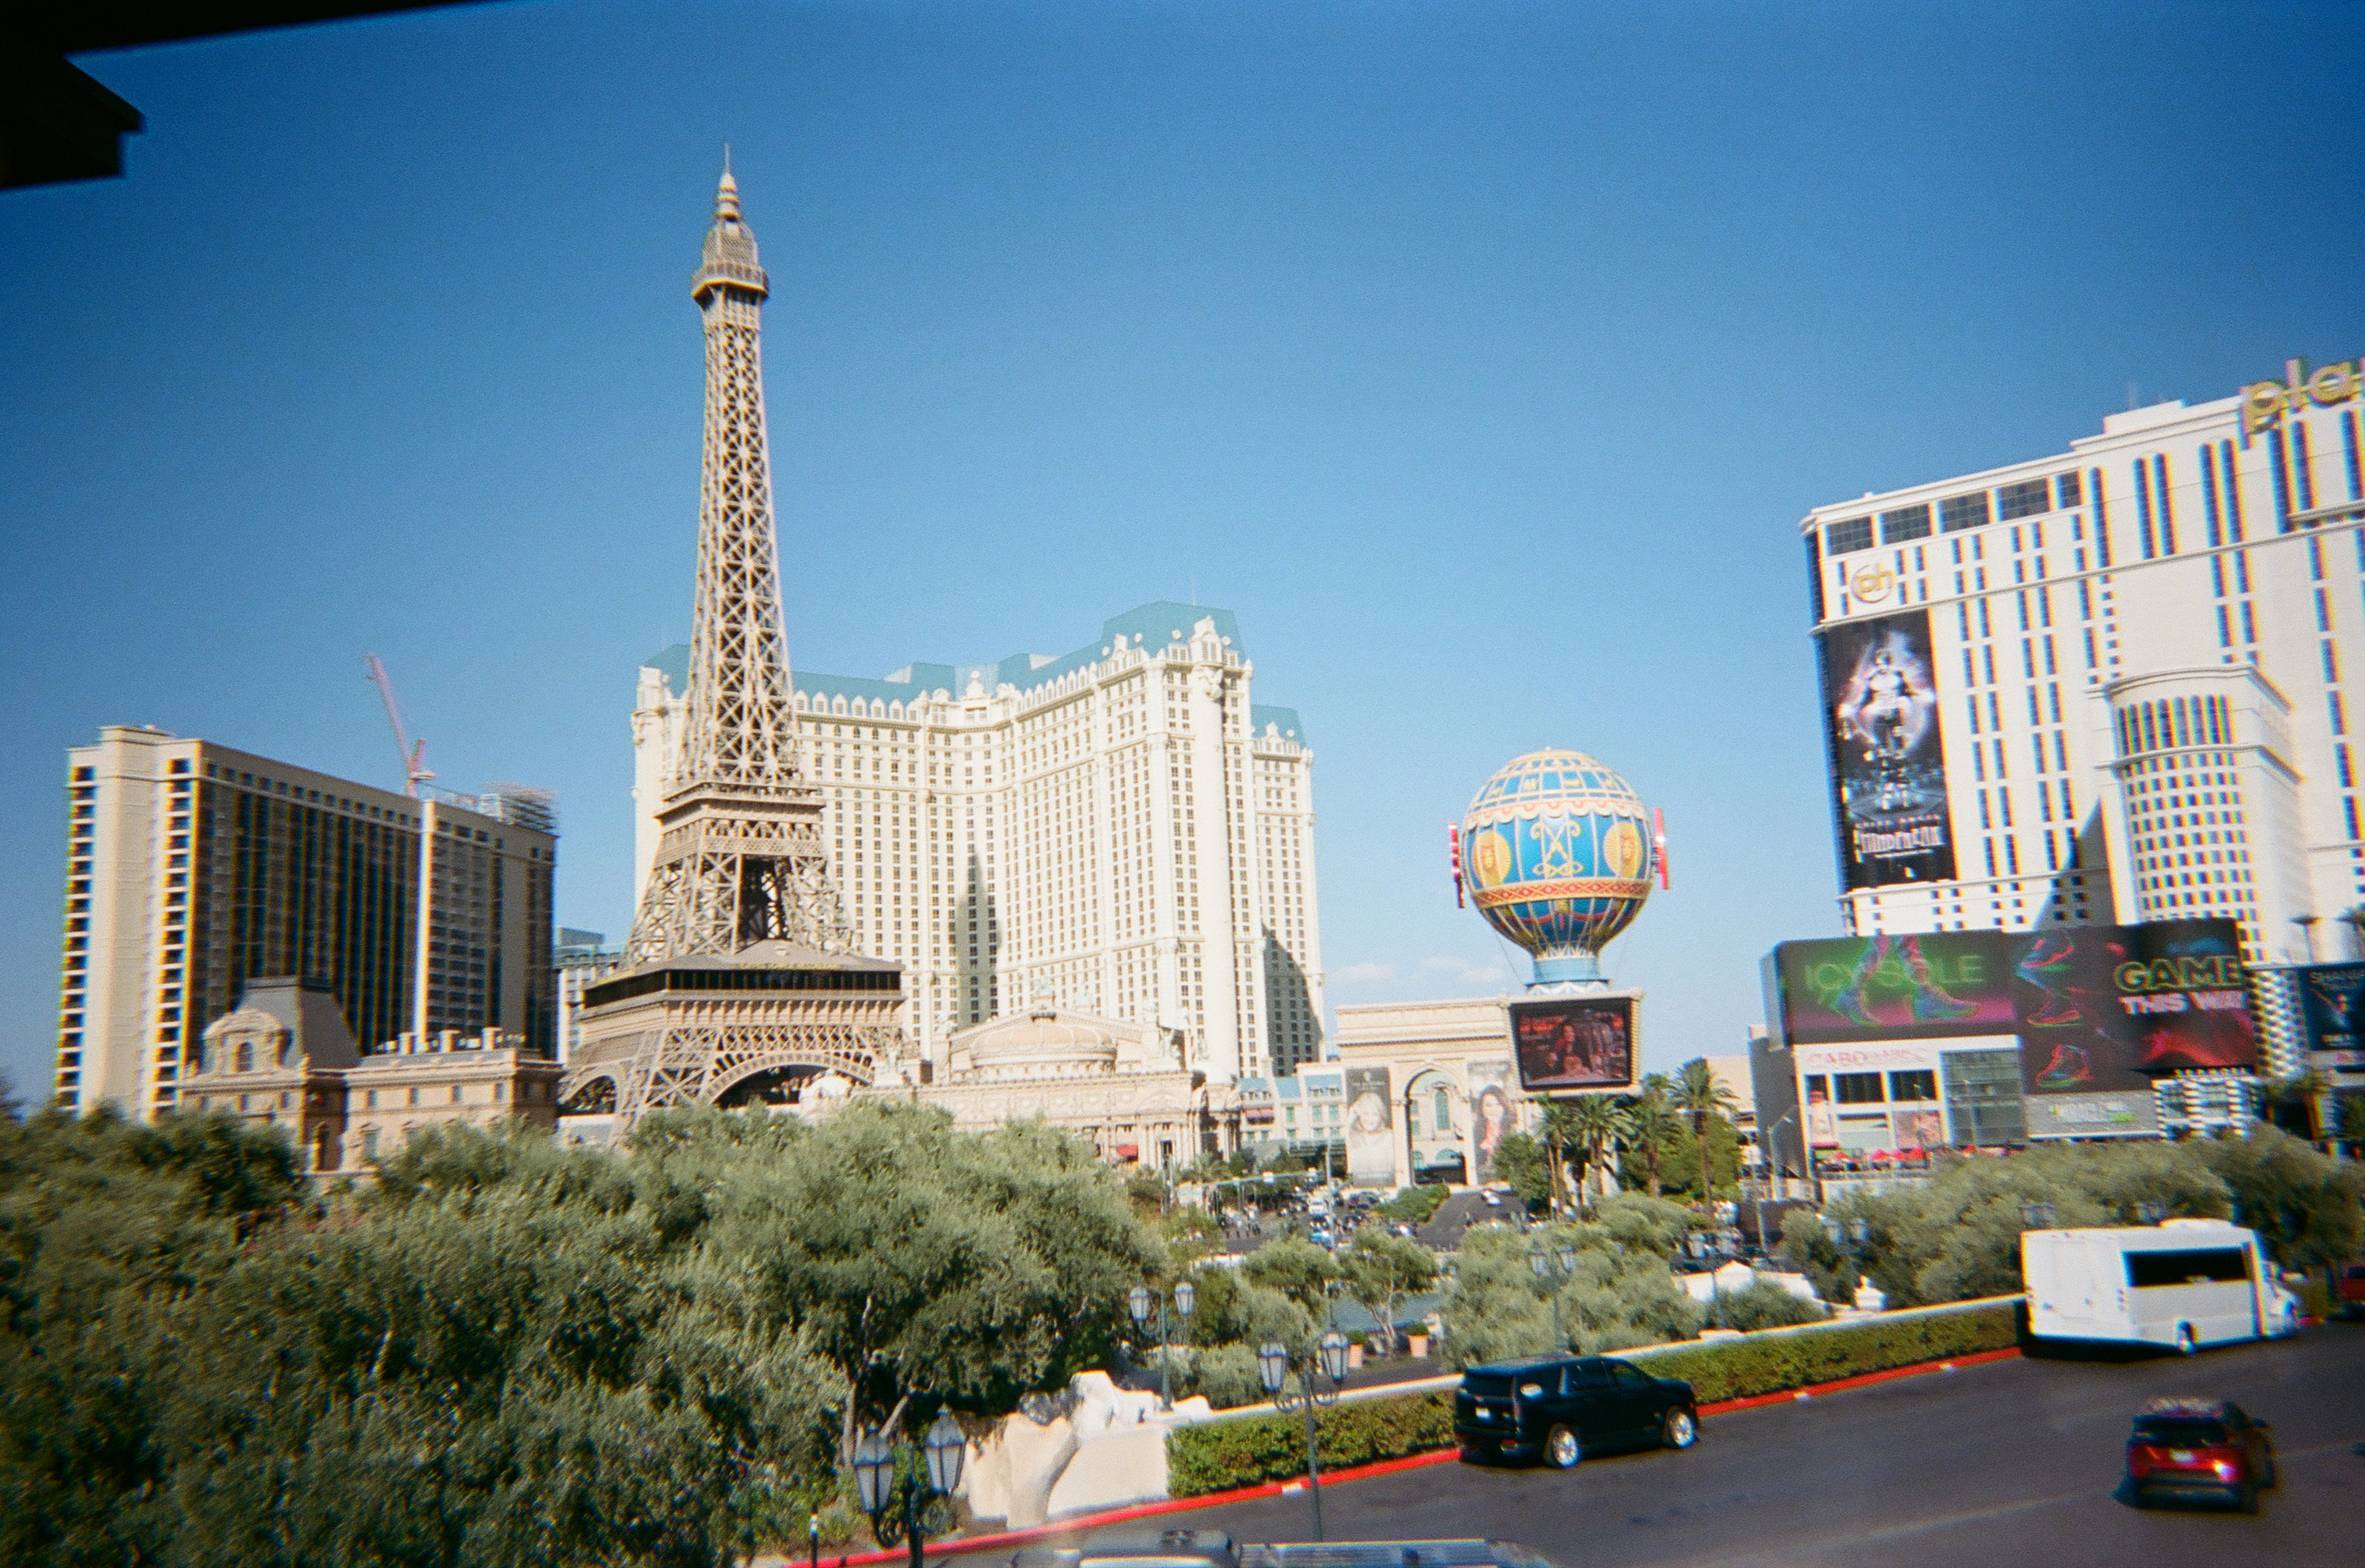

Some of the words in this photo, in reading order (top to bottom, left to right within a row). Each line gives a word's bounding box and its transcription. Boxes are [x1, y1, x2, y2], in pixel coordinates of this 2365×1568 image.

[2238, 357, 2365, 436] pla
[2113, 955, 2244, 992] GAME
[2118, 992, 2189, 1015] THIS
